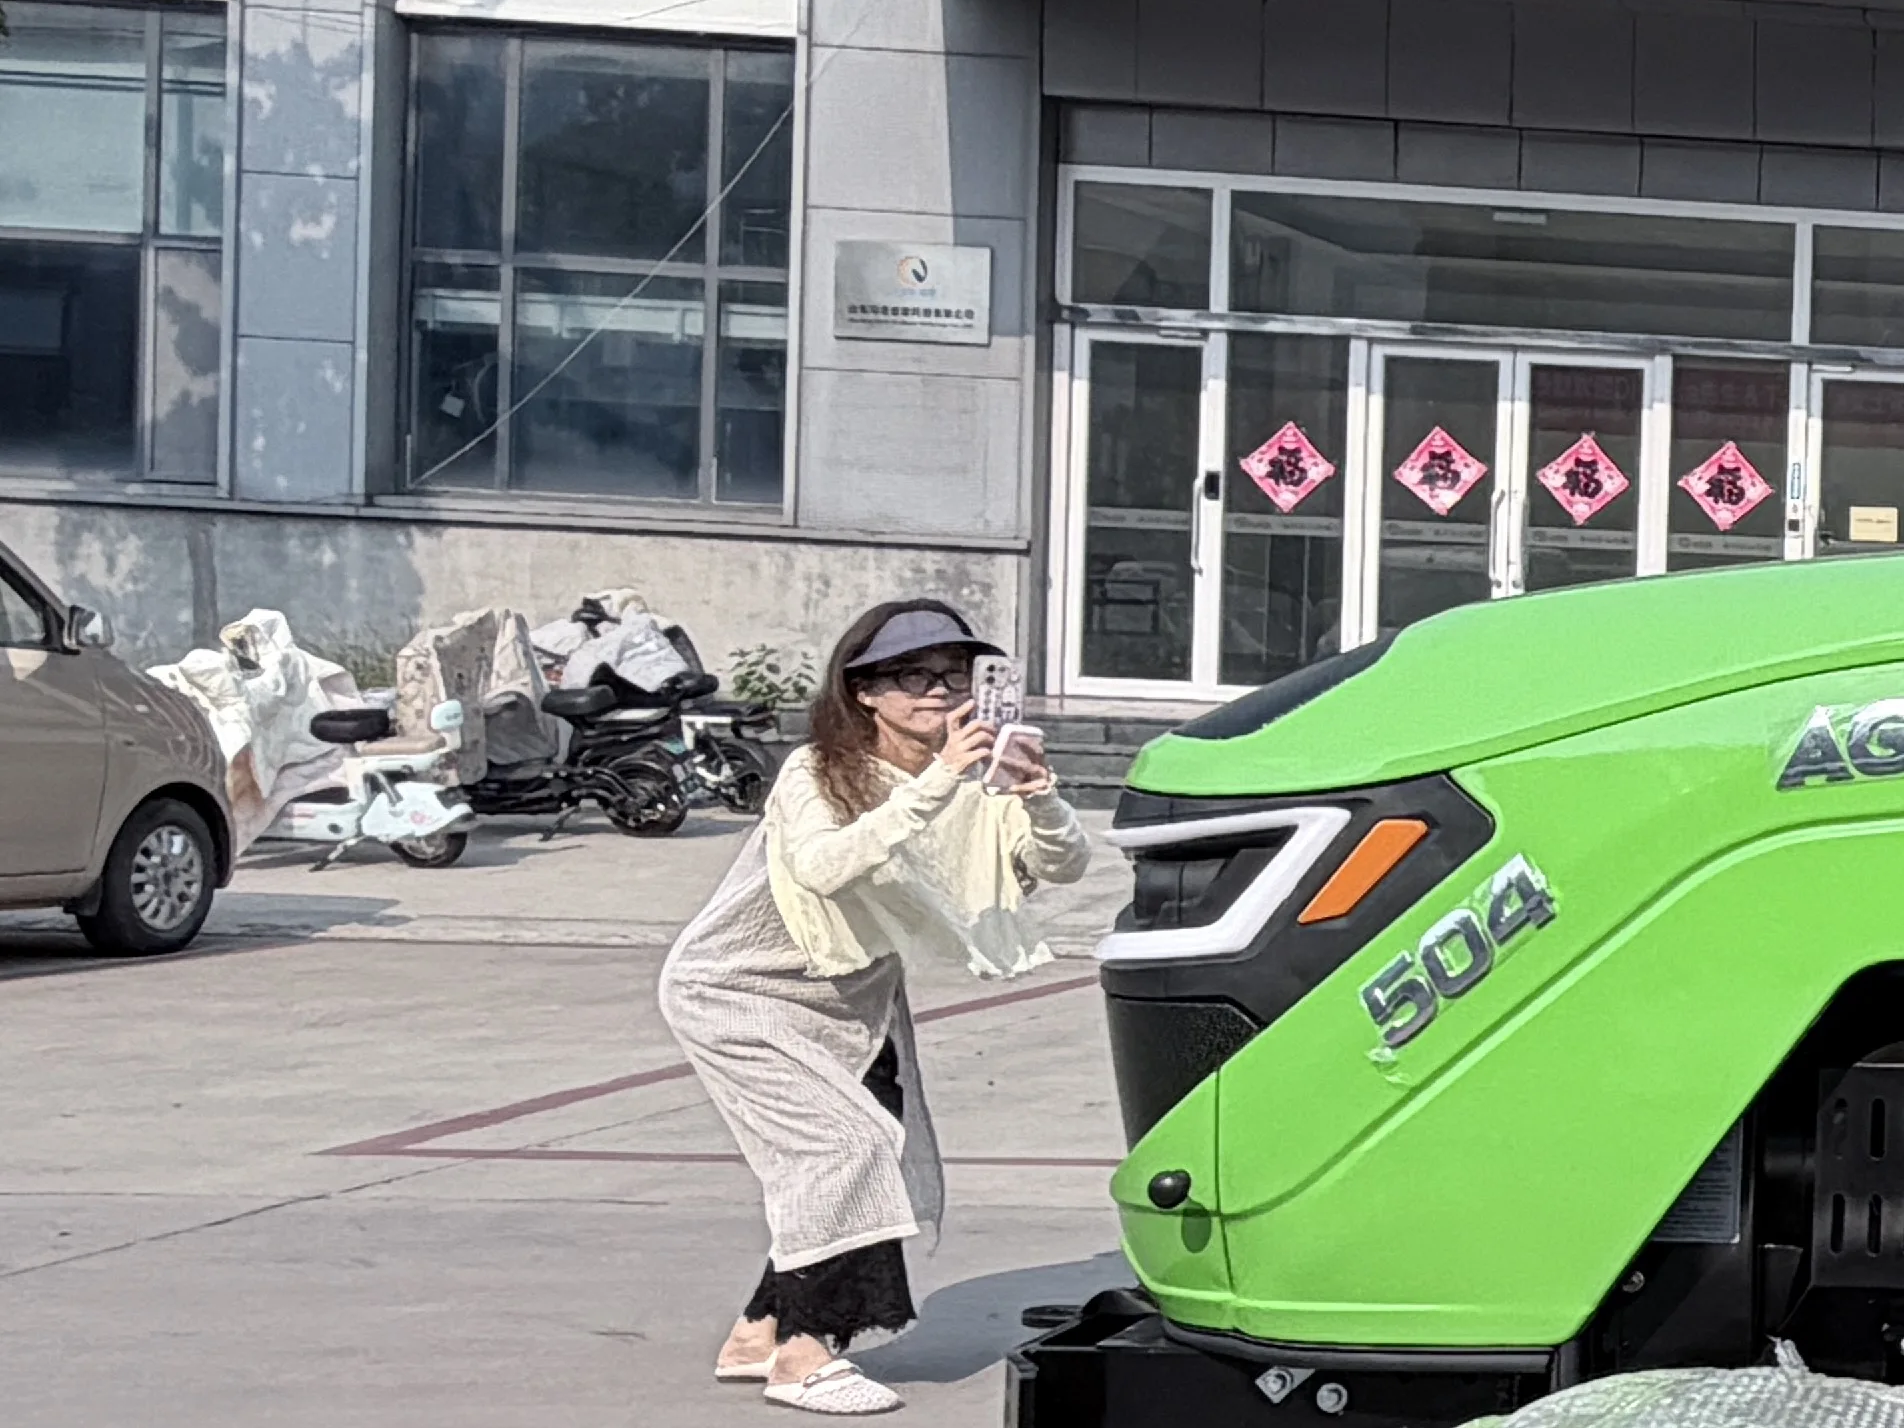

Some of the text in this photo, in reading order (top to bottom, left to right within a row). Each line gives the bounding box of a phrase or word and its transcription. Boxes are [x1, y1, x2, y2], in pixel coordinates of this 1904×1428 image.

[1265, 445, 1306, 487] 福
[1421, 450, 1462, 492] 福
[1562, 458, 1604, 500] 福
[1704, 466, 1746, 506] 福
[1359, 852, 1558, 1049] 504
